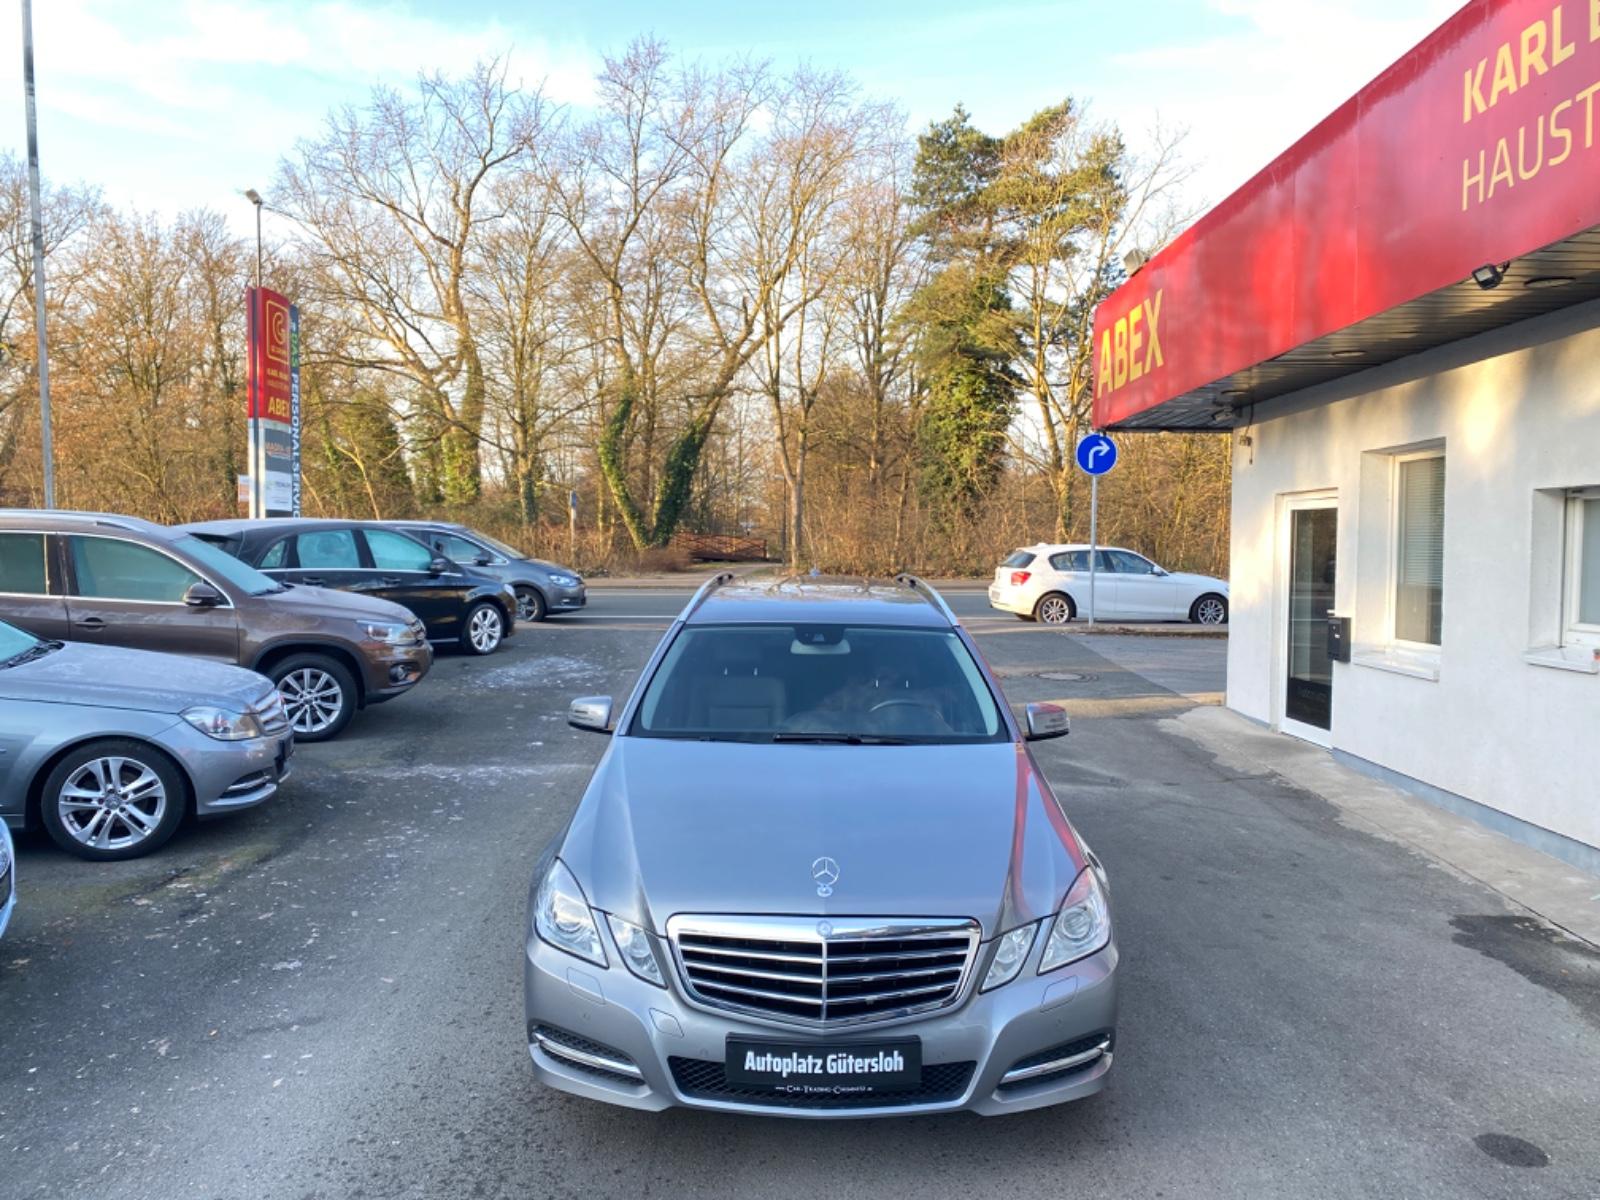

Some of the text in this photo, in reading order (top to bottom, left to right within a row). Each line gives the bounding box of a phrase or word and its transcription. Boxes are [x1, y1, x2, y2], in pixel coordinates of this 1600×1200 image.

[1463, 5, 1575, 124] KARL
[1097, 288, 1164, 399] ABEX
[744, 1050, 904, 1078] Autoplatz Gütersloh
